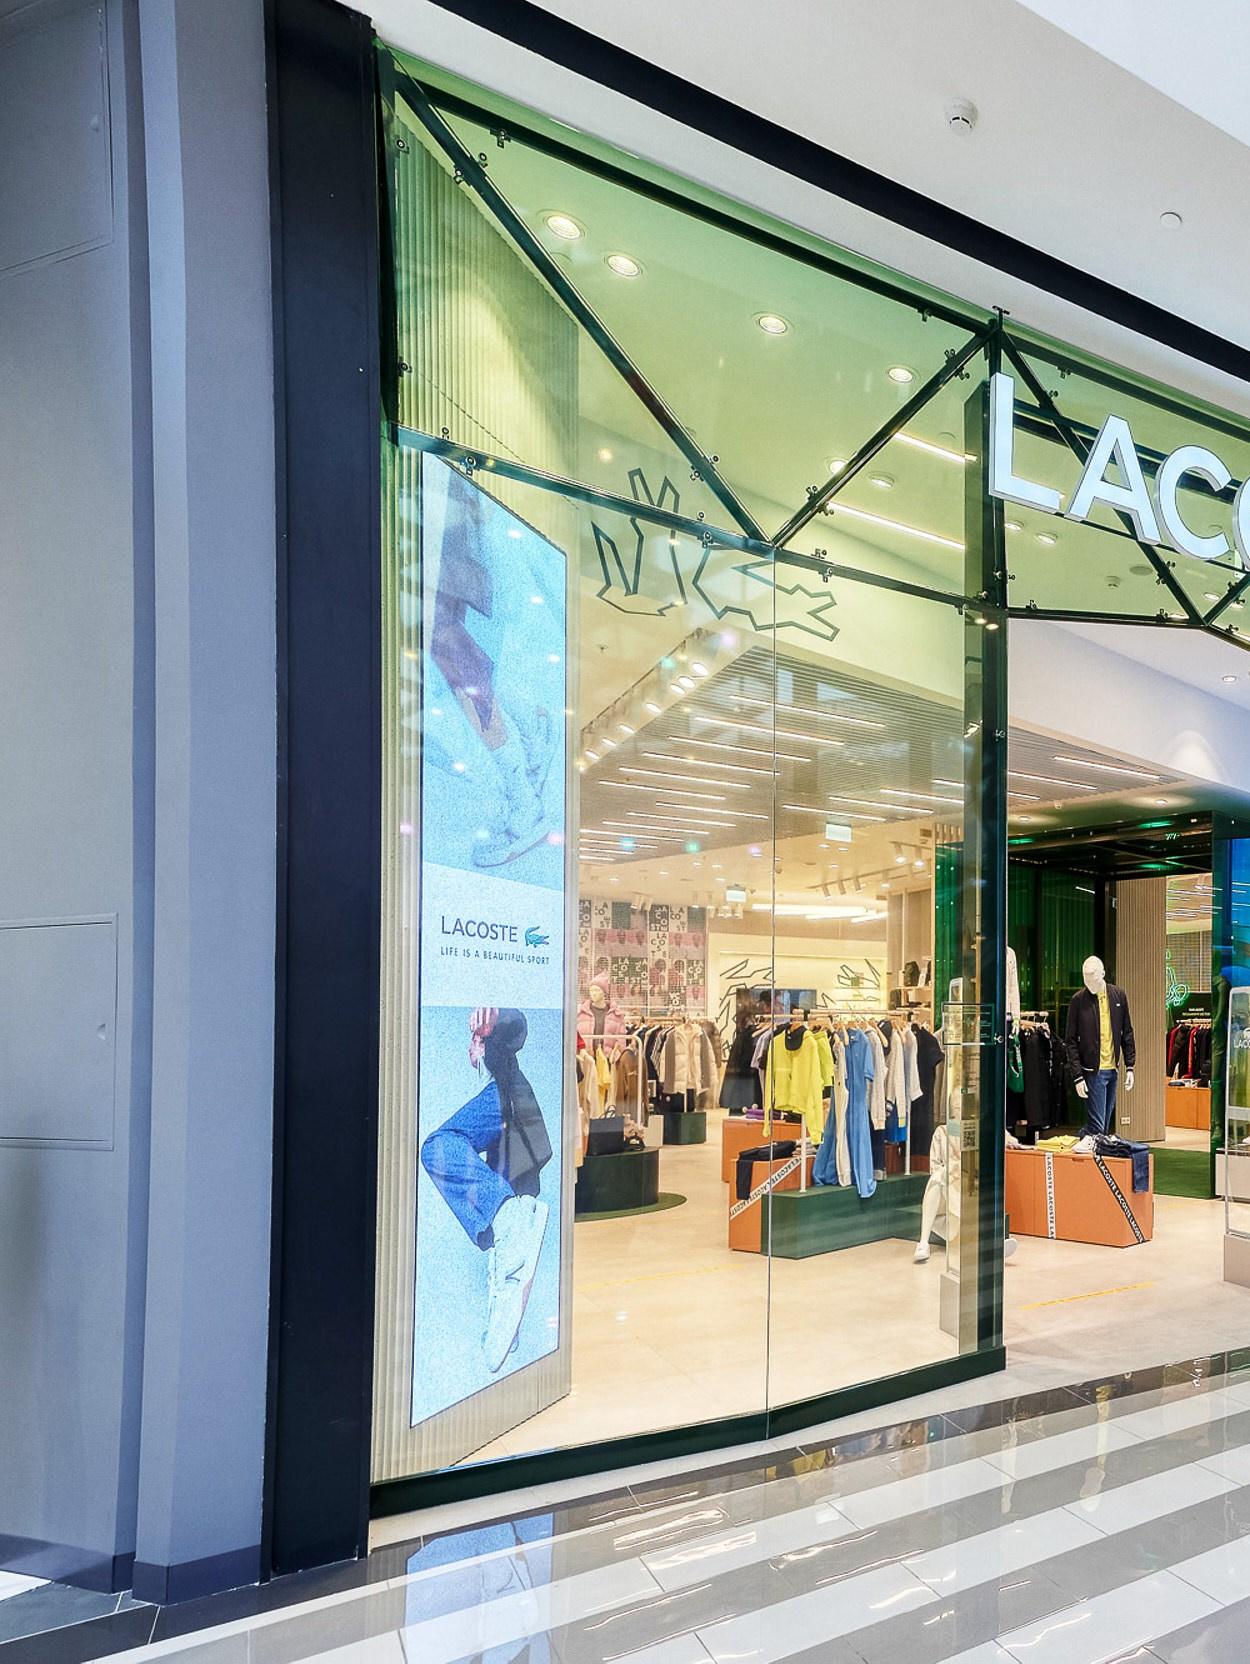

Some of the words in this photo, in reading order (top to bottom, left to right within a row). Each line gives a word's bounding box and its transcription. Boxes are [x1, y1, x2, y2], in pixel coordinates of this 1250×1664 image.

[441, 915, 518, 943] LACOSTE
[440, 946, 458, 957] LIFE
[463, 948, 471, 958] IS
[474, 950, 480, 958] A
[483, 950, 525, 964] BEAUTIFUL
[527, 955, 550, 965] SPORT
